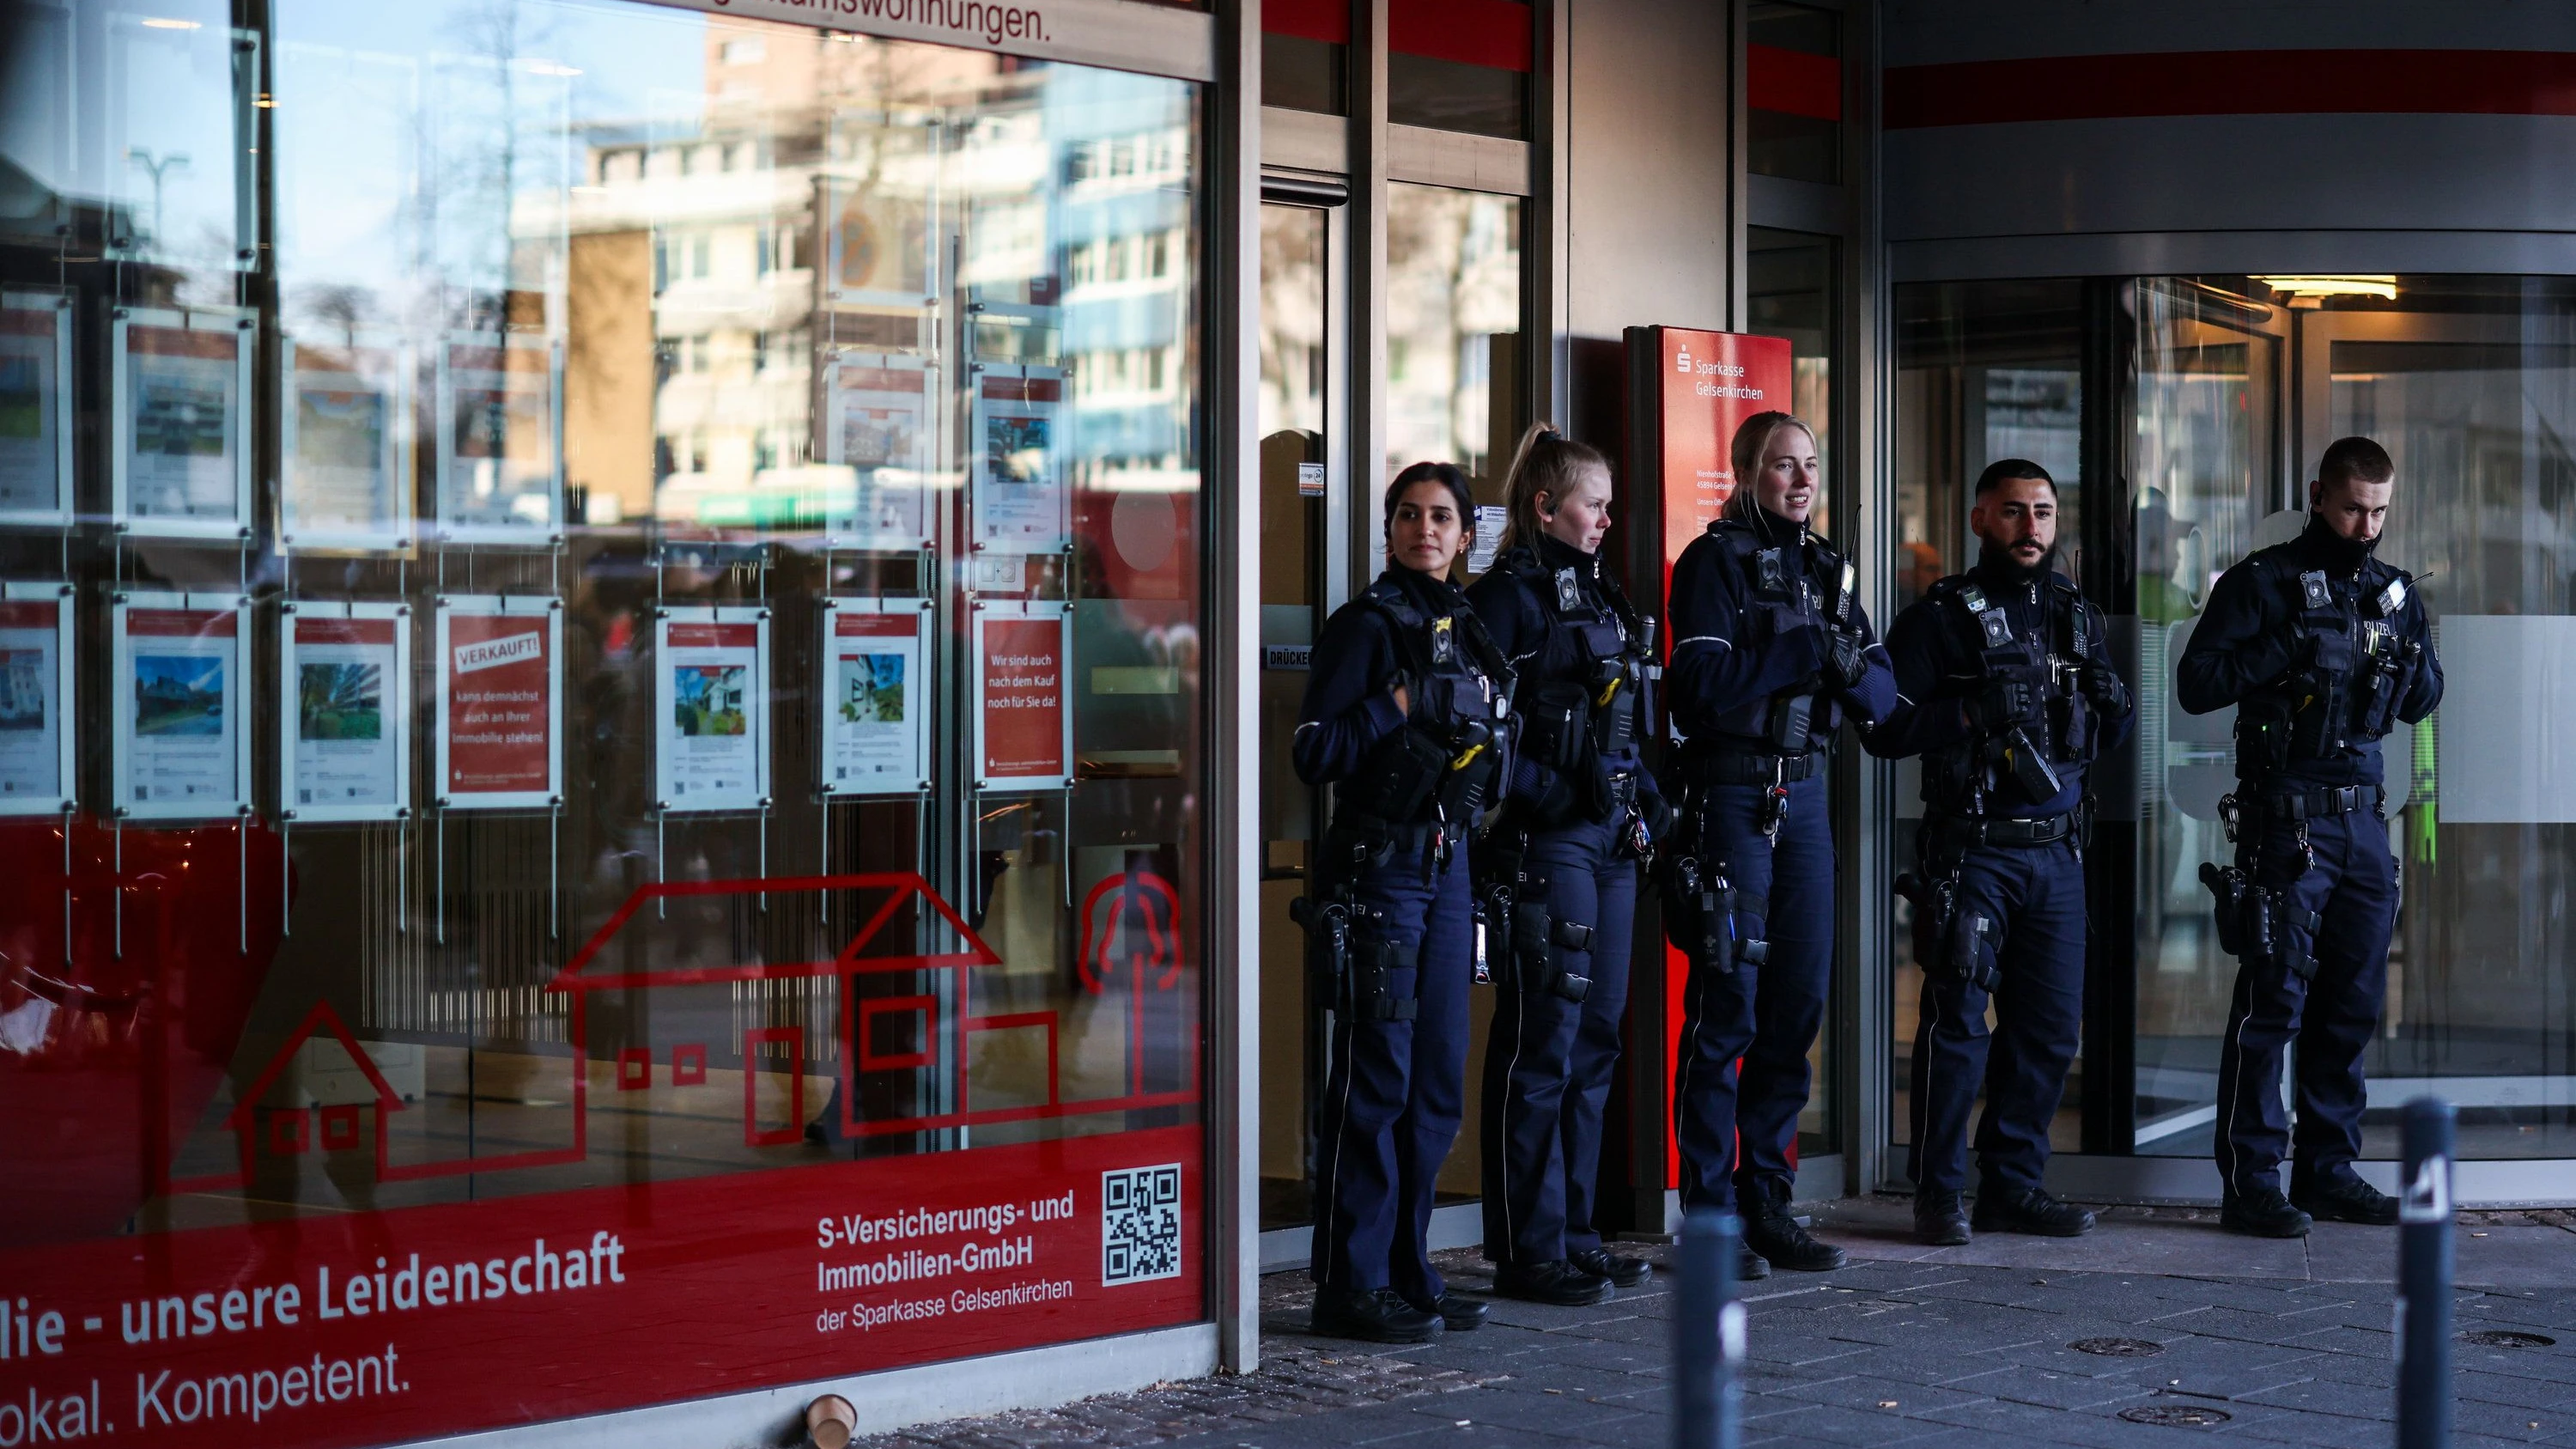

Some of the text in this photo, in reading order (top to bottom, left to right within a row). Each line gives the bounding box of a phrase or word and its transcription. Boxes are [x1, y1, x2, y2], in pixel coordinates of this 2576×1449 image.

[1696, 359, 1745, 378] Sparkasse
[1696, 381, 1763, 400] Gelsenkirchen
[459, 637, 538, 666] VERKAUFT!
[991, 654, 1052, 667] Wir sind auch
[988, 674, 1054, 688] nach dem Kauf
[456, 690, 539, 703] kann demnächst
[987, 695, 1056, 709] noch für Sie da!
[464, 711, 531, 723] auch an Ihrer
[452, 732, 503, 744] Immobilie
[817, 1190, 1075, 1249] S-Versicherungs- und
[817, 1235, 1033, 1291] Immobilien-GmbH
[0, 1297, 64, 1360] lie
[122, 1282, 301, 1344] unsere
[319, 1230, 626, 1321] Leidenschaft
[817, 1277, 1073, 1332] der Sparkasse Gelsenkirchen
[0, 1342, 410, 1447] okal. Kompetent.
